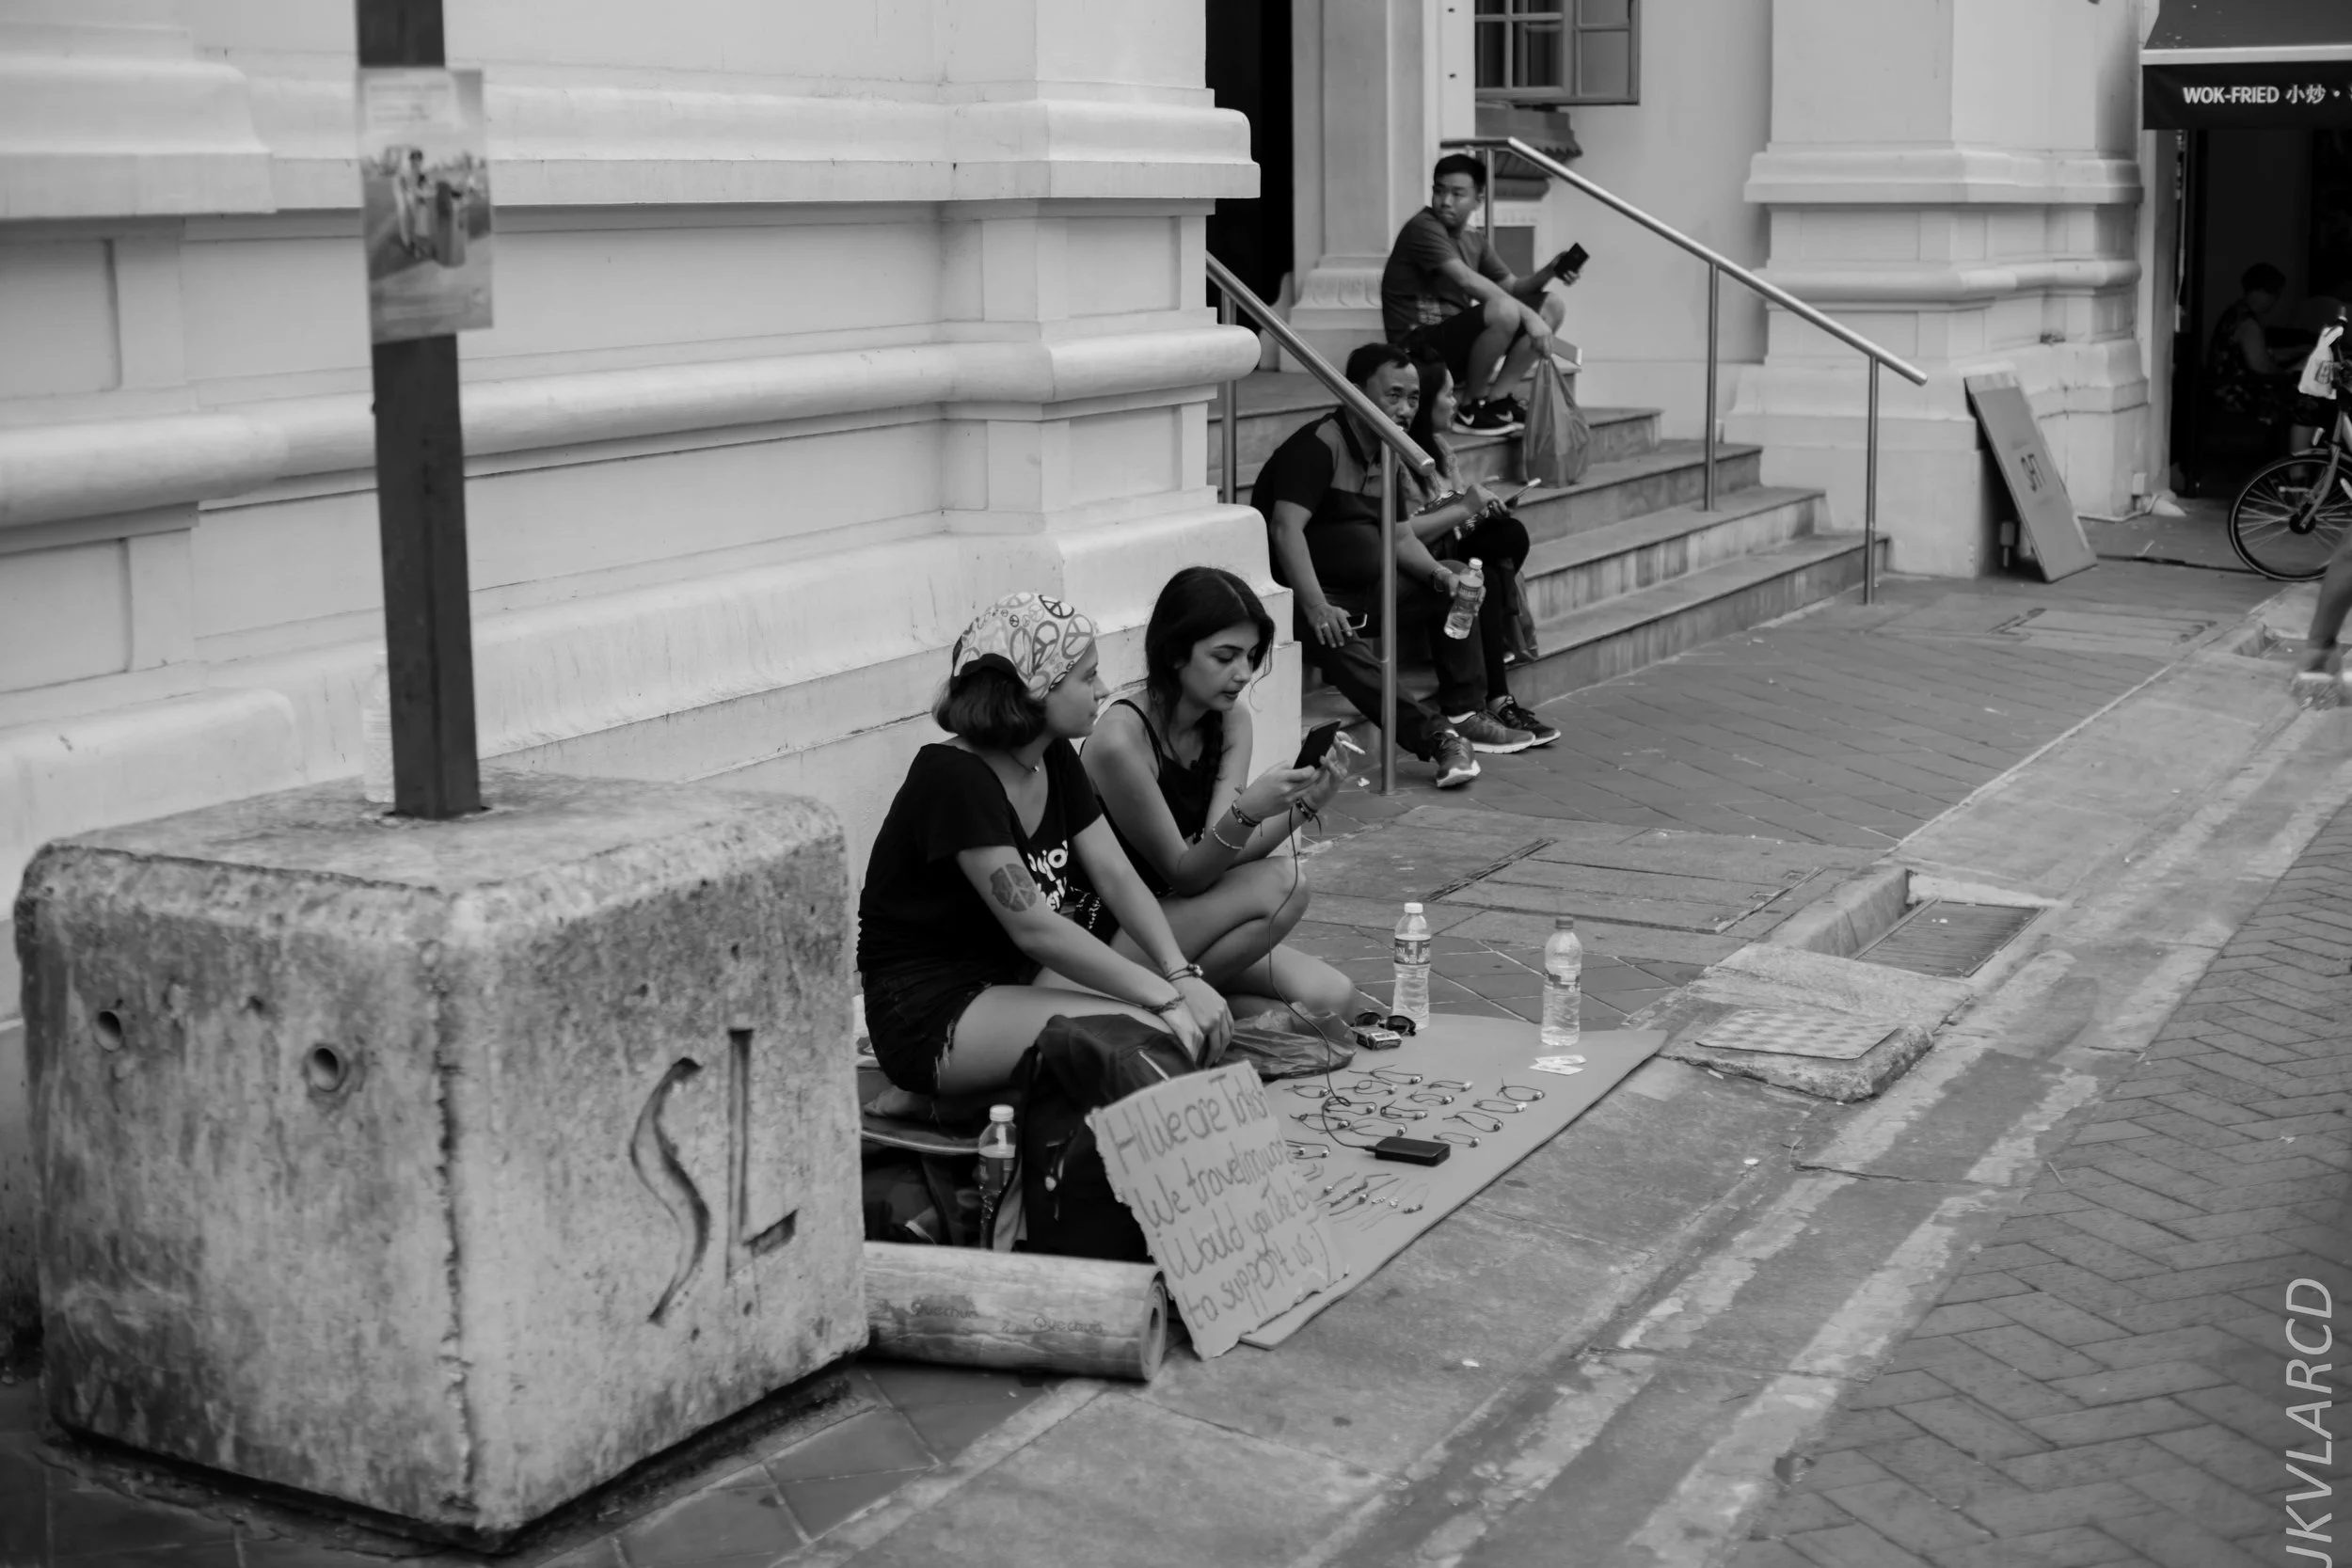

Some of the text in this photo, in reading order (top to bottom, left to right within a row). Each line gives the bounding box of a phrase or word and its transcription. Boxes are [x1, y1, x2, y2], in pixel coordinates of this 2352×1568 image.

[2183, 86, 2280, 103] WOK-FRIED
[2286, 84, 2327, 103] 小炒
[1134, 1174, 1191, 1228] We
[1160, 1201, 1245, 1280] Would
[1182, 1291, 1219, 1329] to
[1220, 1246, 1294, 1317] support
